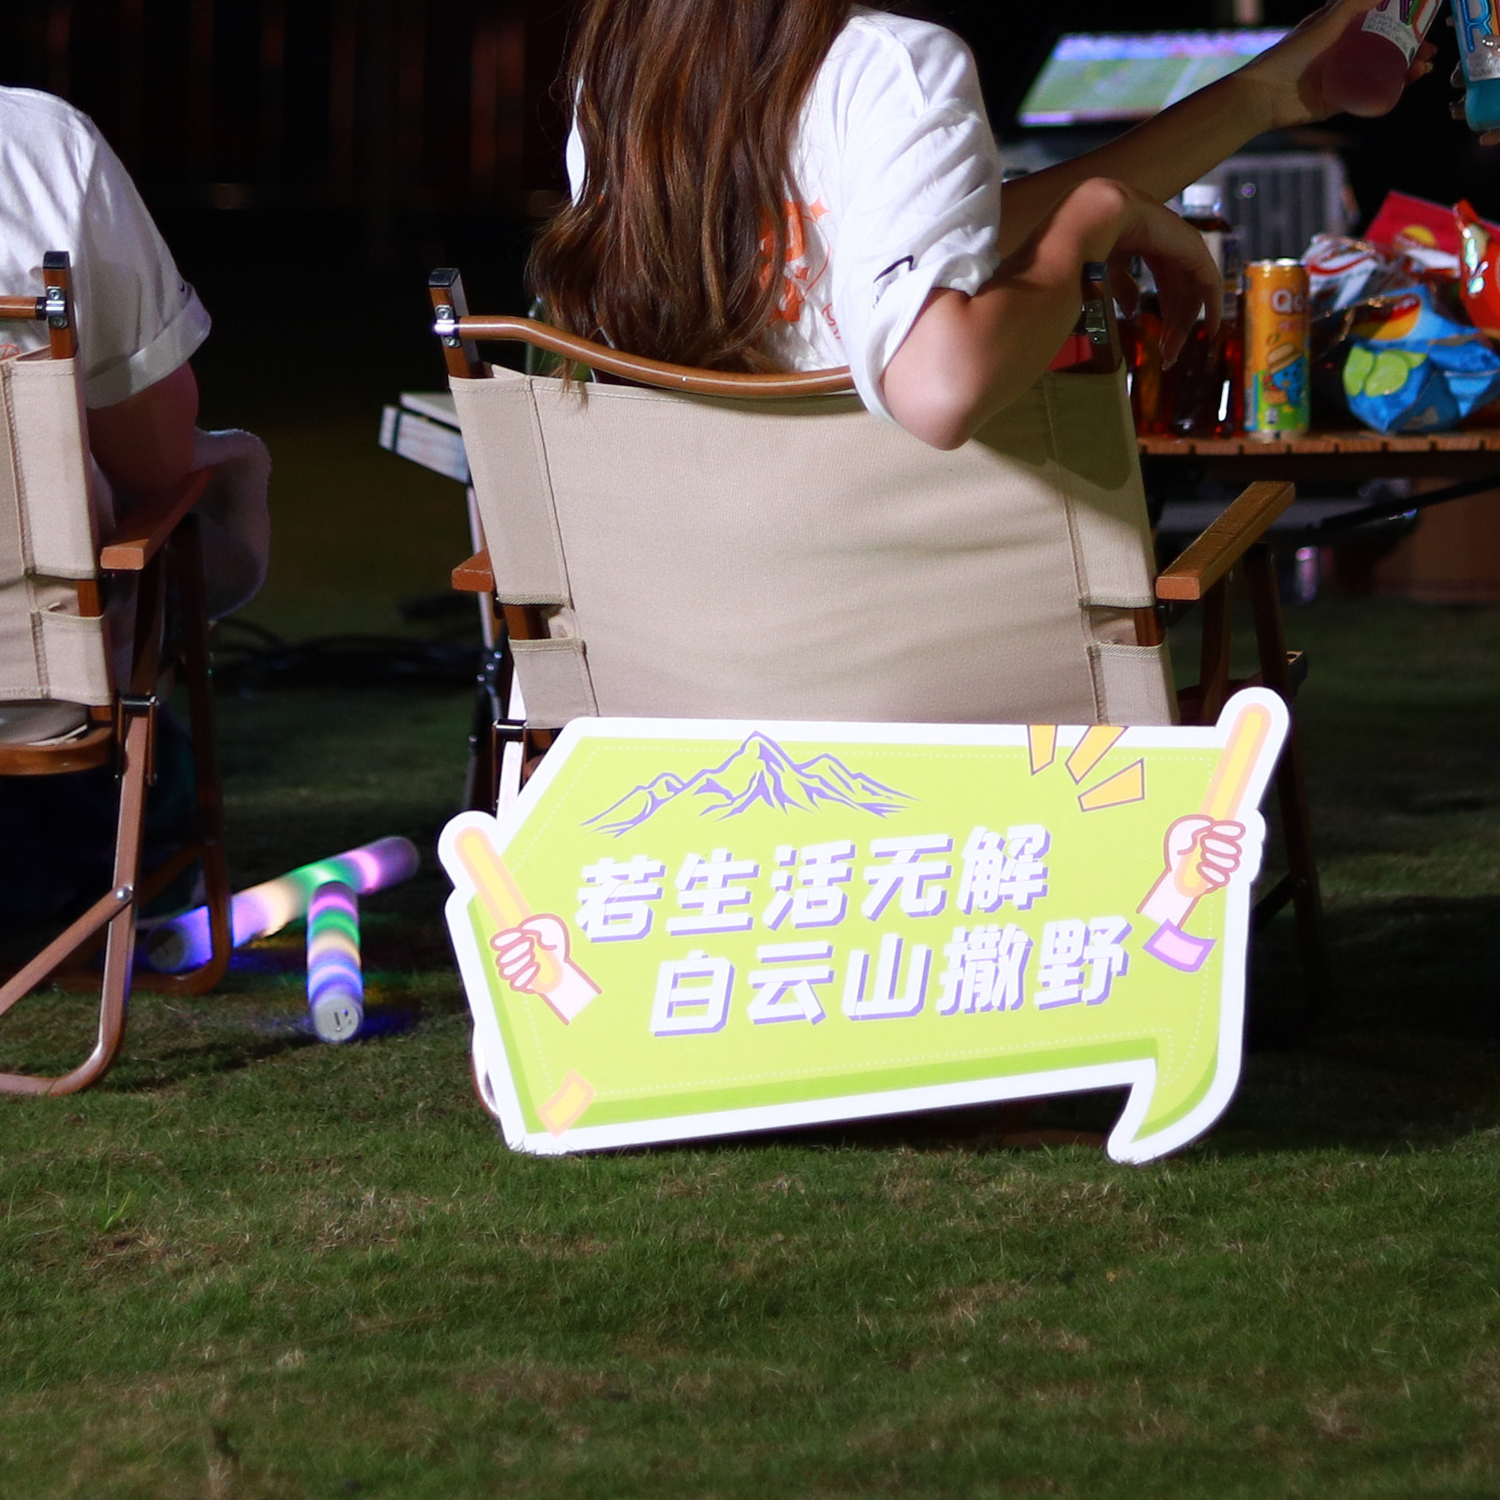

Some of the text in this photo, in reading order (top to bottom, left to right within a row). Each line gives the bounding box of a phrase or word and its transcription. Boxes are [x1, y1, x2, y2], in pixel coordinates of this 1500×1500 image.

[575, 823, 1052, 943] 若生活无解
[650, 914, 1133, 1037] 白云山撒野
